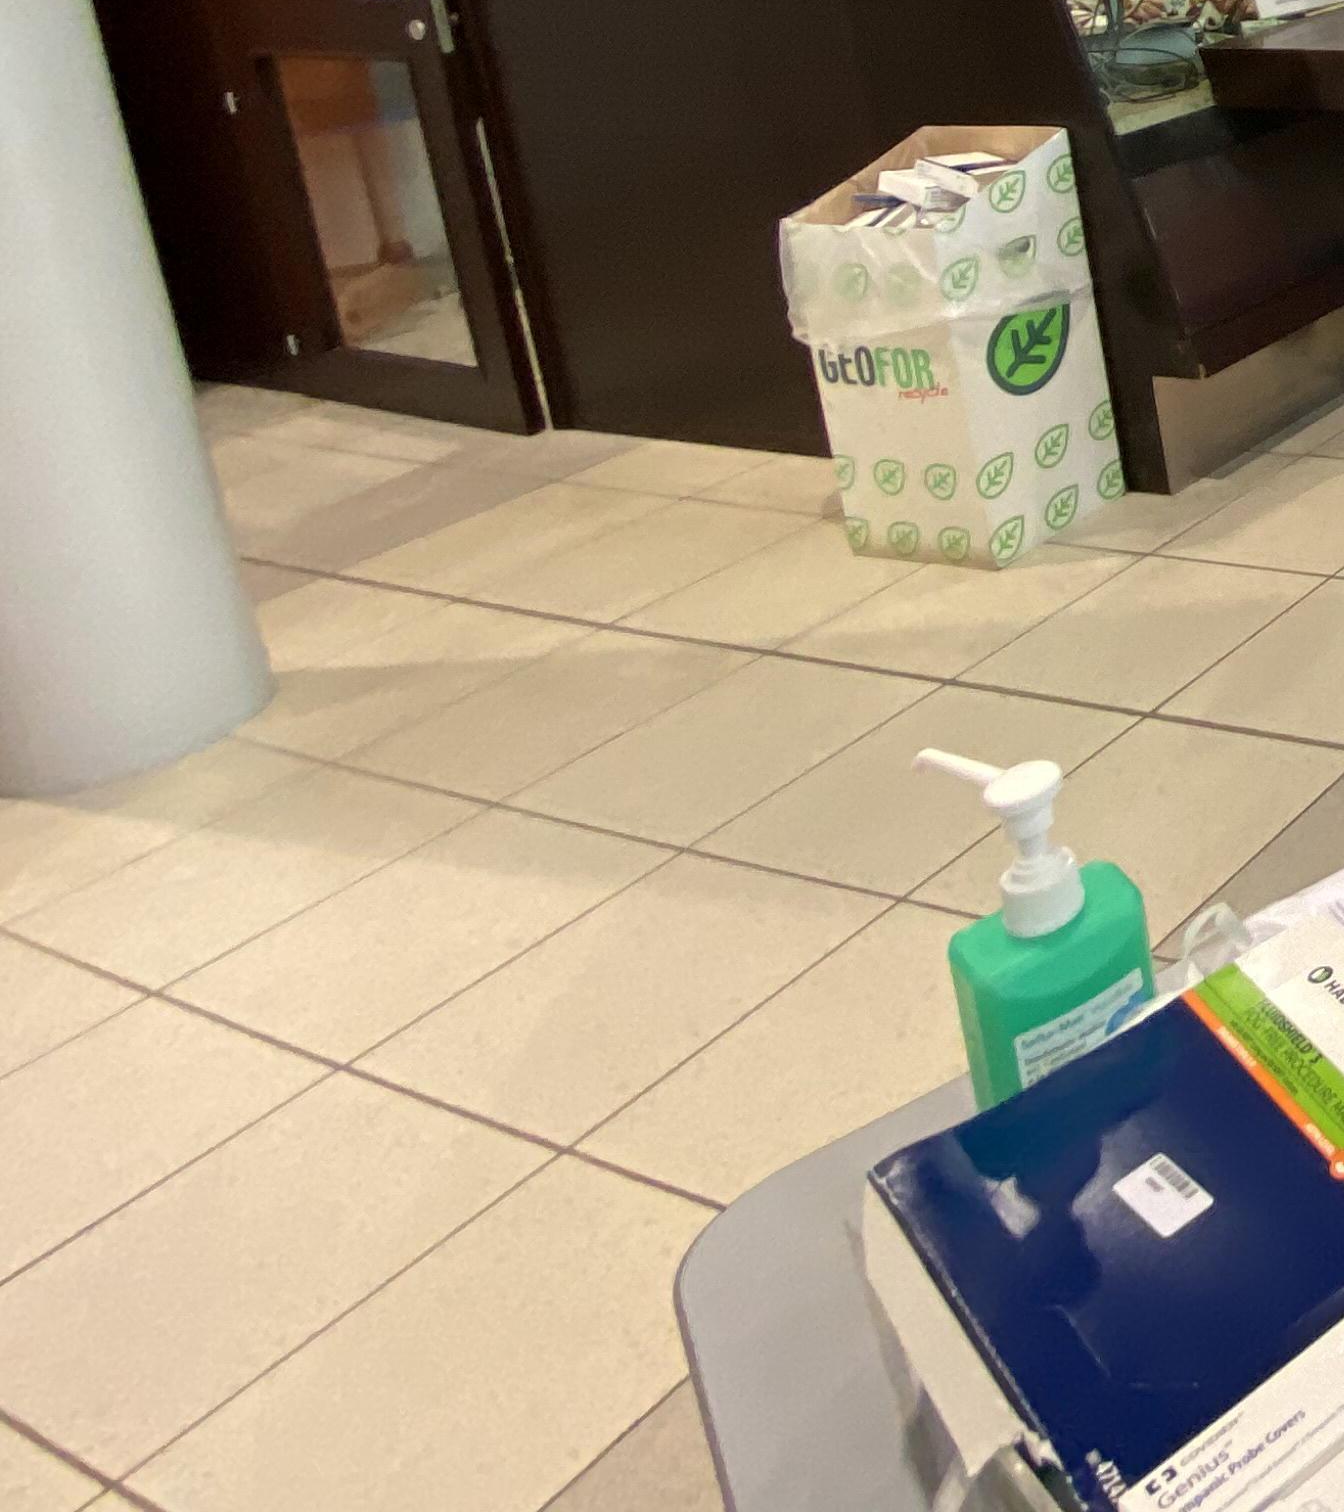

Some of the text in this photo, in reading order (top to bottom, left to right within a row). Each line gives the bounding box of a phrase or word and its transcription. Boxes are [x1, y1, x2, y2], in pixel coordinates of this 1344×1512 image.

[1228, 1442, 1265, 1475] Probe
[1265, 1409, 1306, 1444] Covers
[1157, 1450, 1230, 1509] Genius
